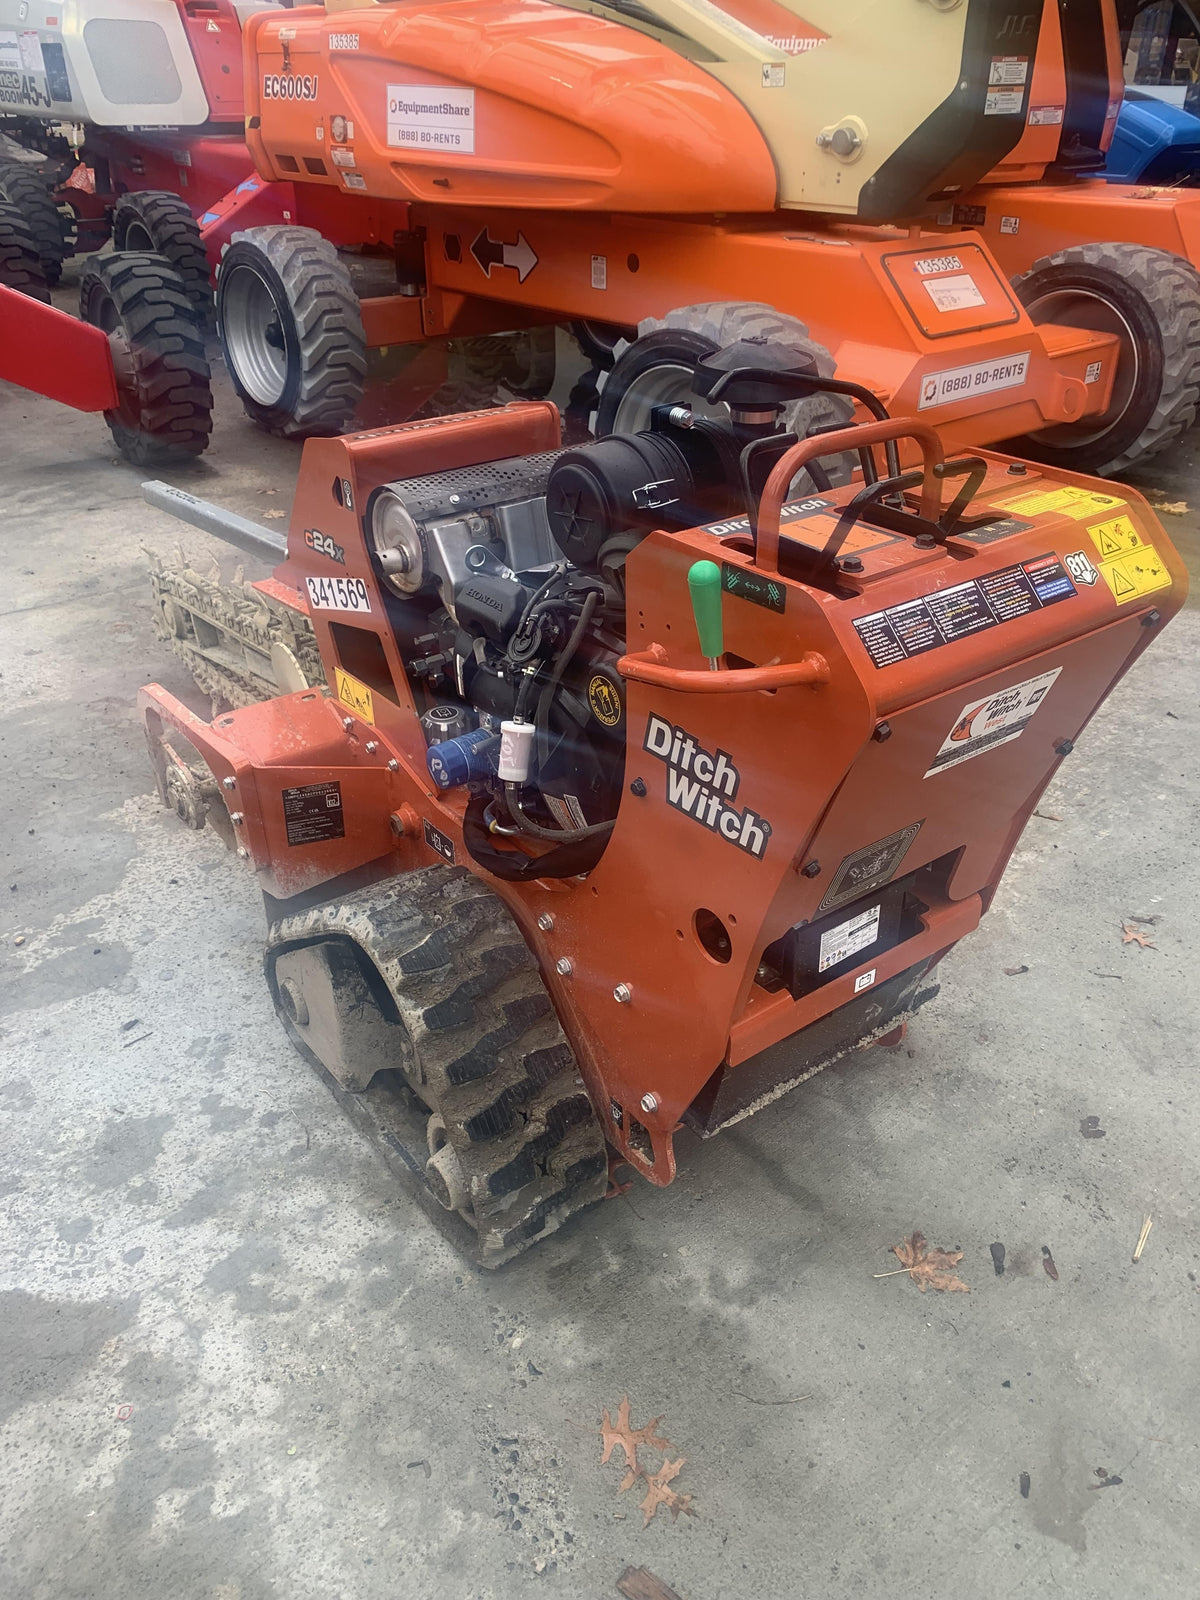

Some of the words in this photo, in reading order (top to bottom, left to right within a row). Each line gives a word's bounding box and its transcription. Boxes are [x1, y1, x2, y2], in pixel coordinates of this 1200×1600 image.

[329, 34, 359, 49] 135385
[263, 75, 318, 100] EC600SJ
[398, 101, 470, 116] EquipmentShare
[398, 130, 418, 142] (888)
[420, 132, 461, 145] 80-RENTS
[917, 256, 962, 274] 135385
[942, 376, 971, 395] (888)
[974, 363, 1024, 386] 80-RENTS
[1066, 553, 1092, 576] 811
[307, 578, 369, 610] 341569
[465, 588, 504, 613] HONDA
[985, 690, 1021, 713] Ditch
[986, 699, 1022, 721] Witch
[647, 717, 737, 796] Ditch
[669, 767, 765, 855] Witch
